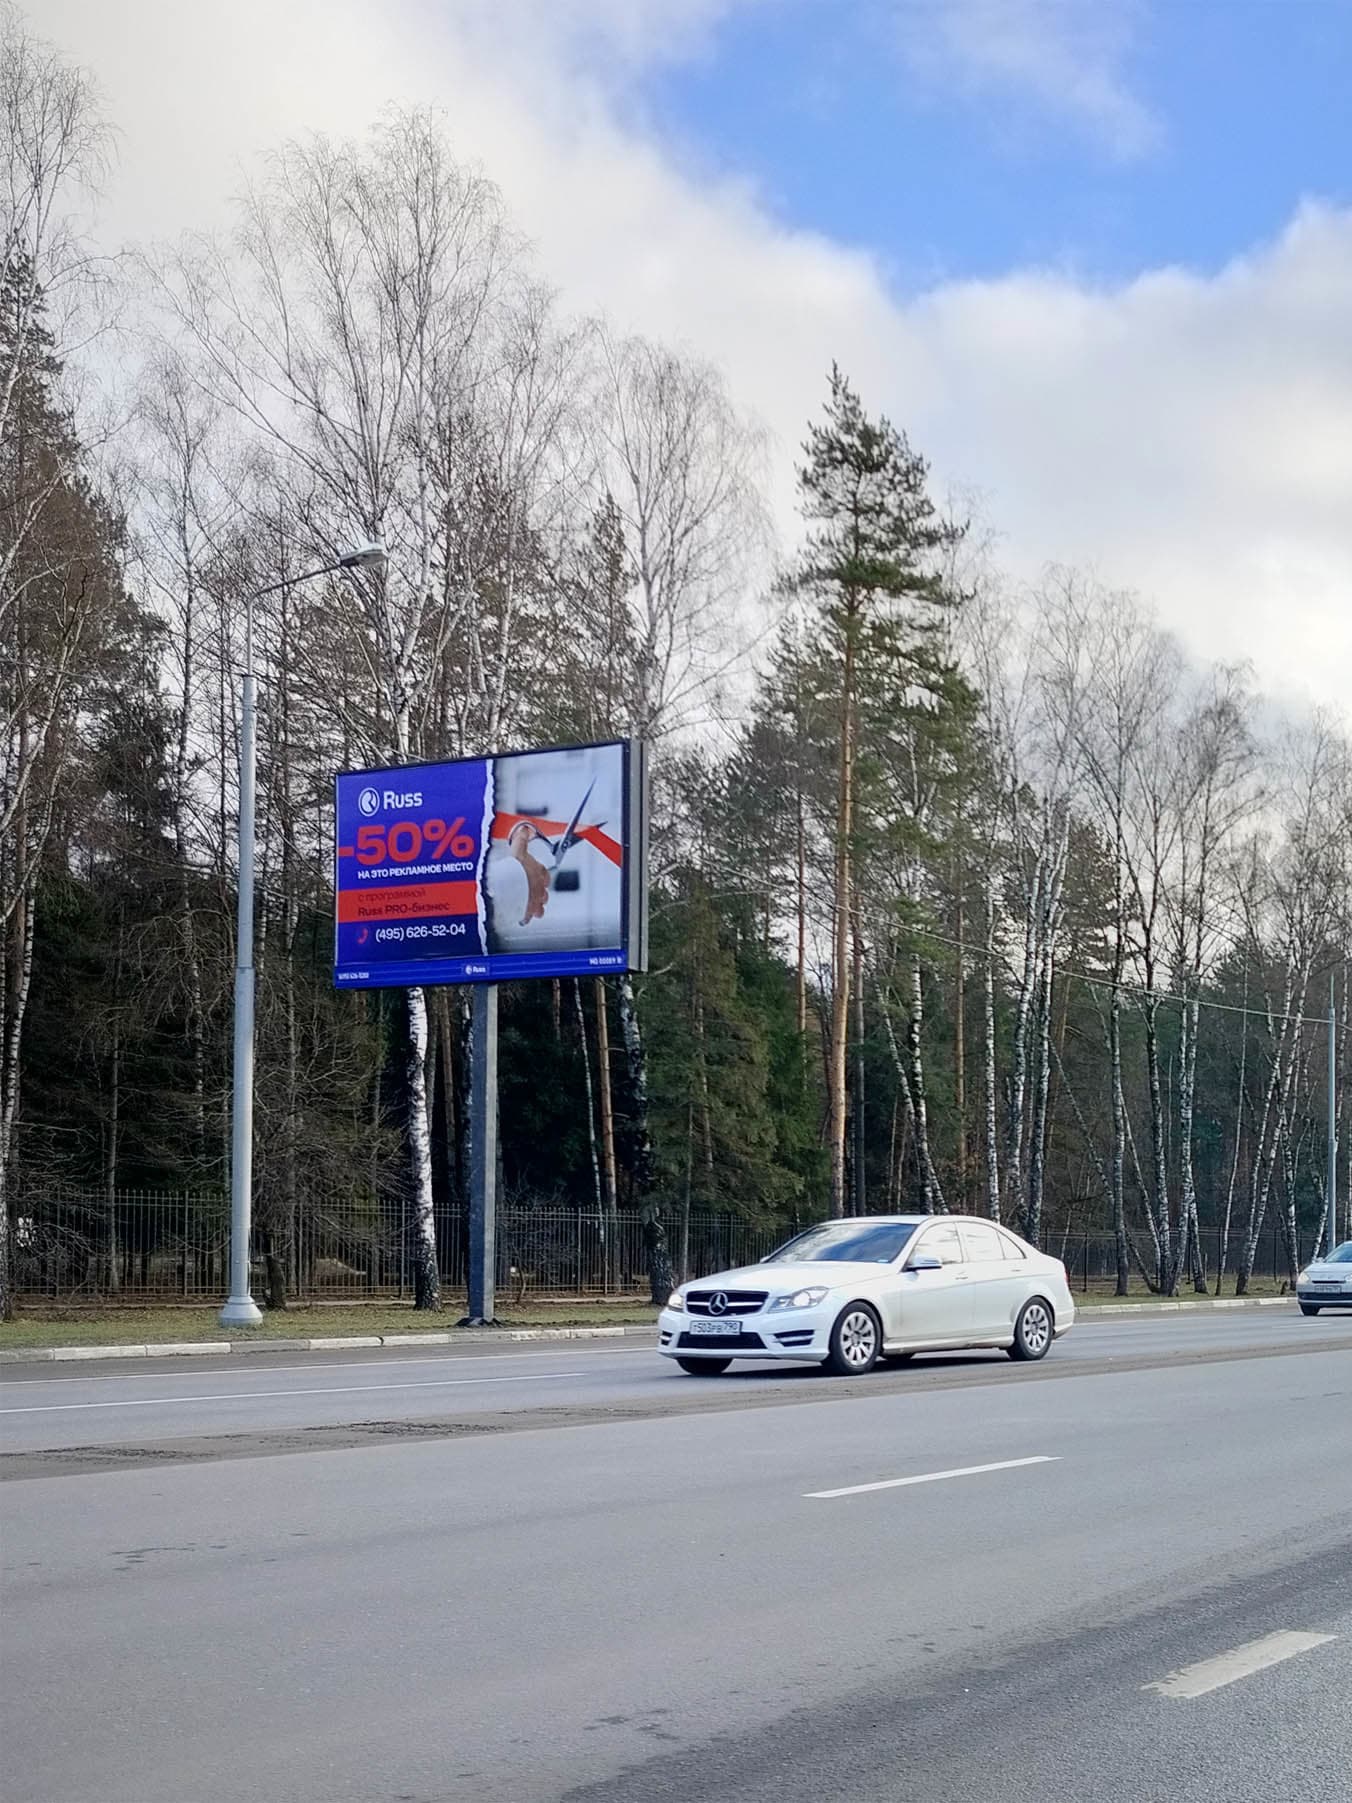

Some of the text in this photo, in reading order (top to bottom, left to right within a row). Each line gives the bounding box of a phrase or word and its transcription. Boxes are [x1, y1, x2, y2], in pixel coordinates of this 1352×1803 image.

[383, 790, 423, 810] Russ
[338, 817, 475, 866] -50%
[358, 861, 474, 880] НА ЭТО РЕКЛАМНОЕ МЕСТО
[365, 887, 426, 903] программой
[358, 902, 450, 917] Russ PRO-бизнес
[375, 923, 466, 943] (495) 626-52-04
